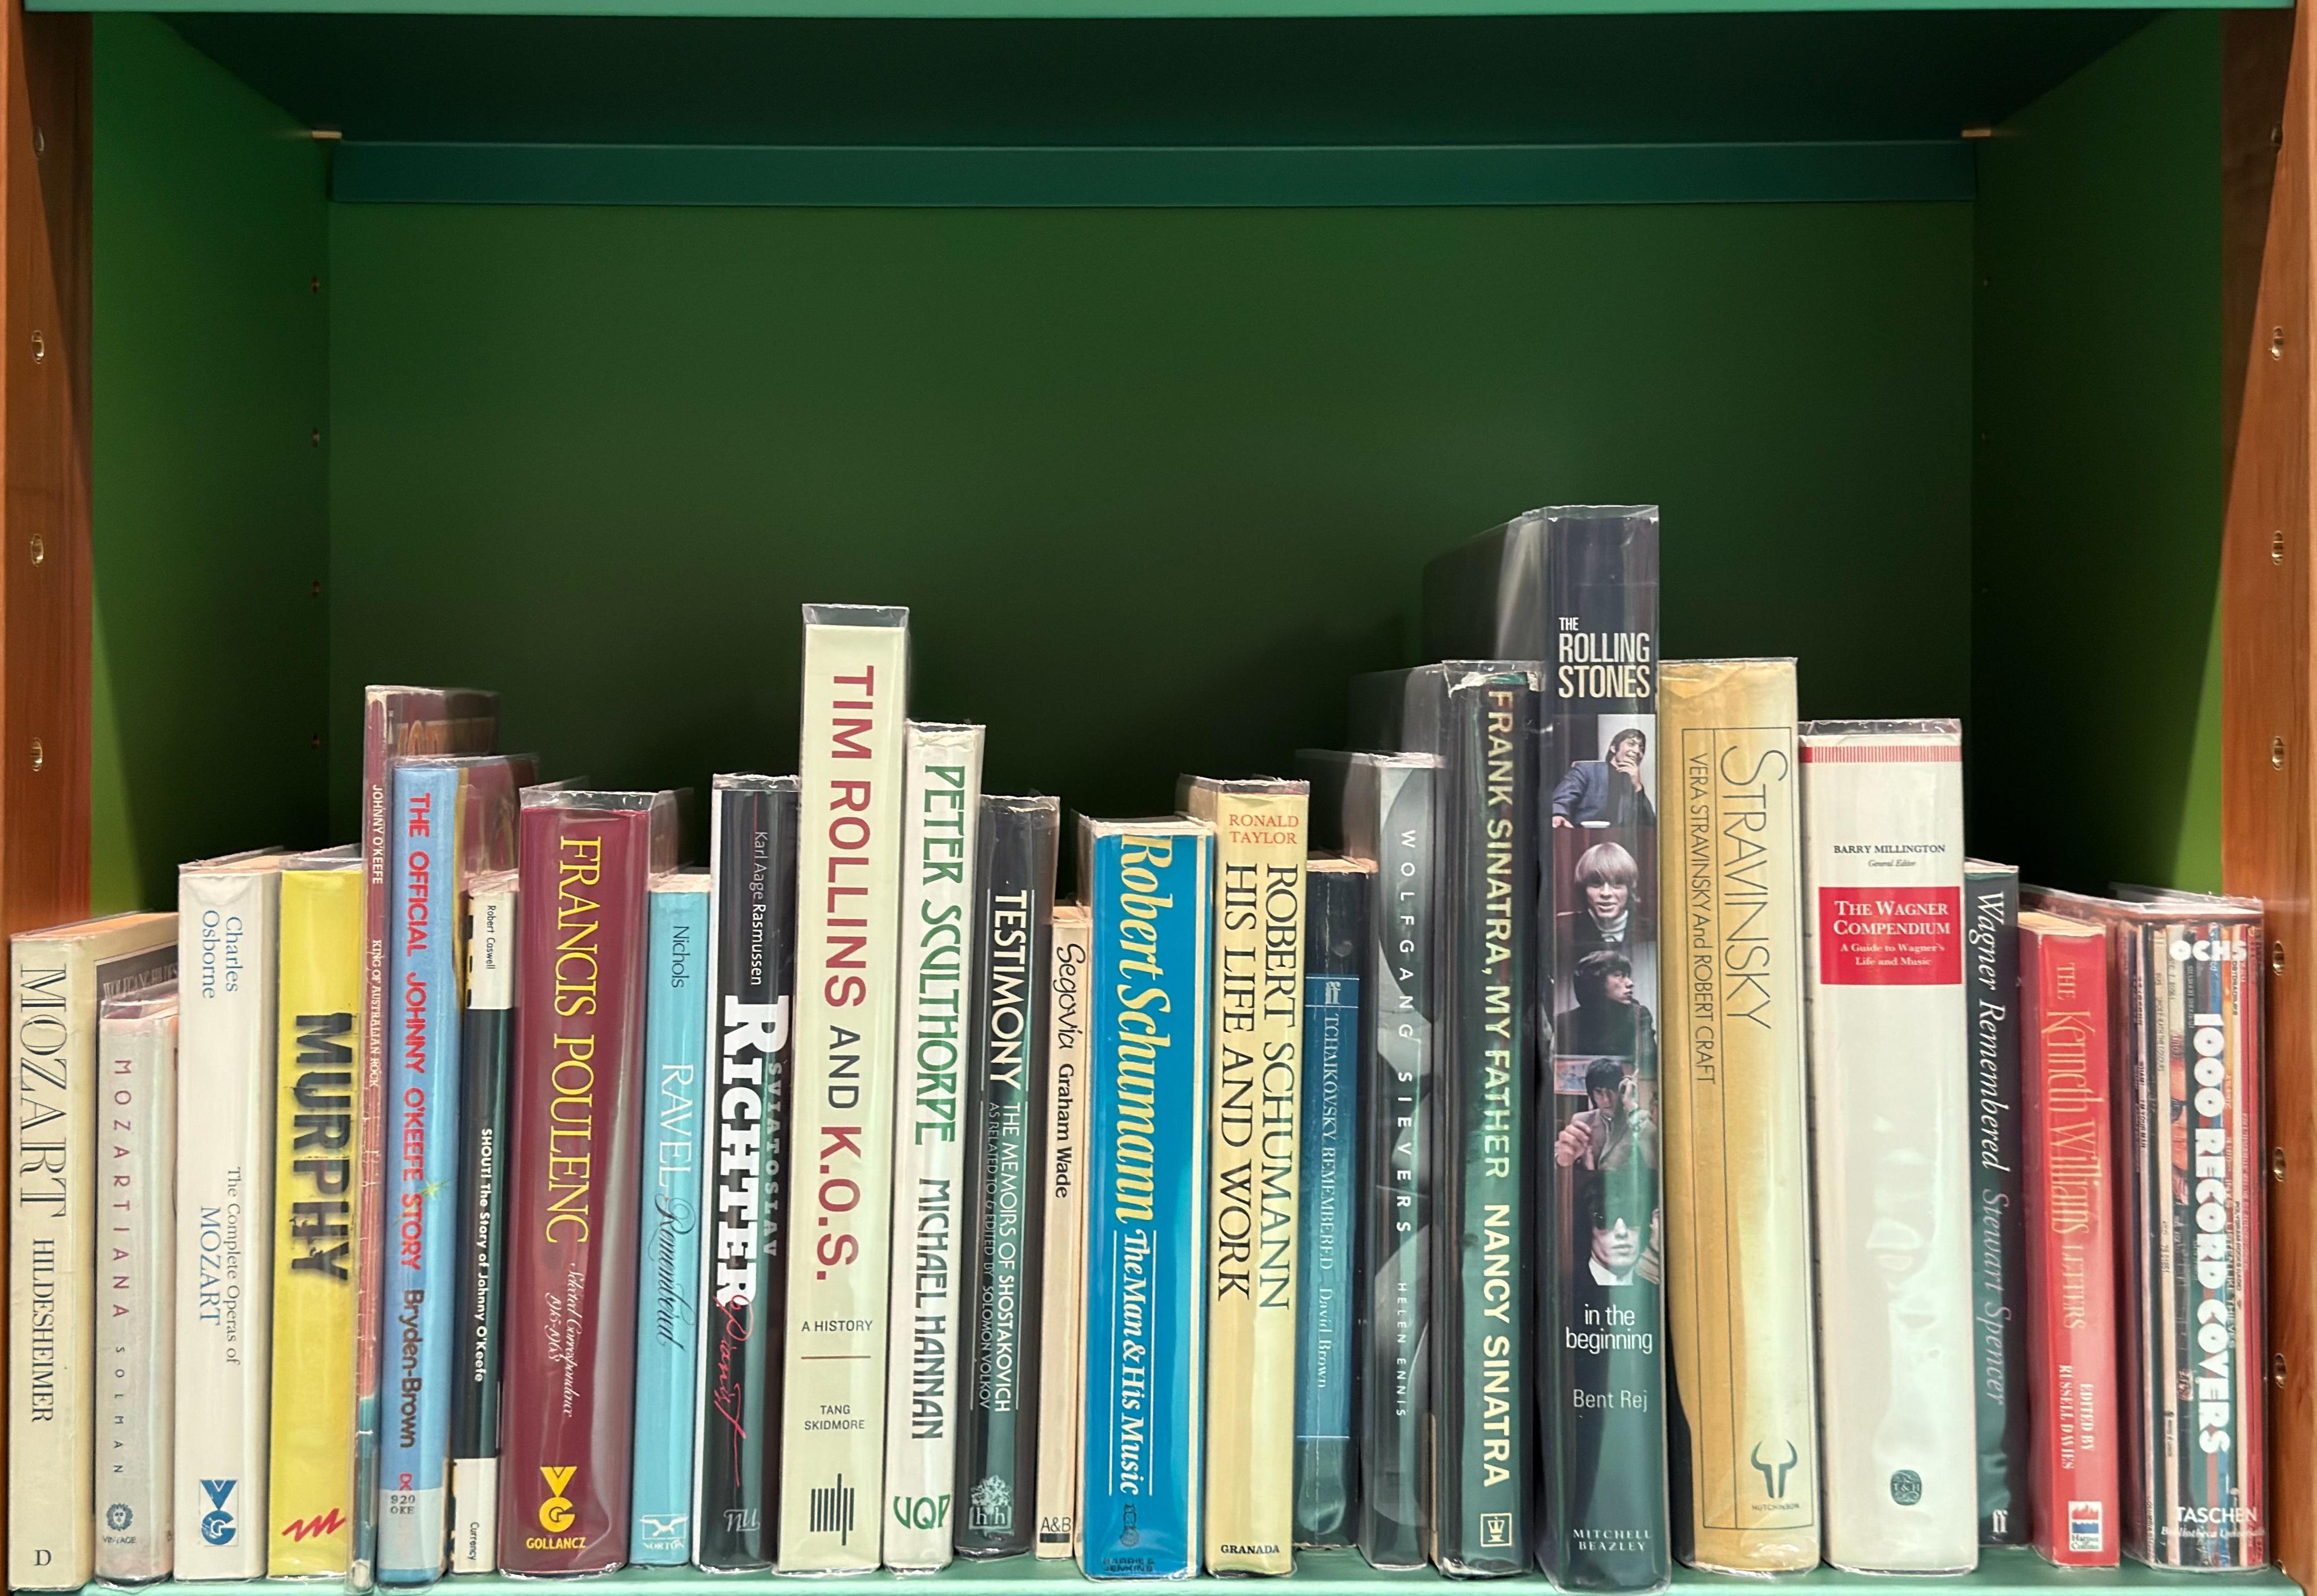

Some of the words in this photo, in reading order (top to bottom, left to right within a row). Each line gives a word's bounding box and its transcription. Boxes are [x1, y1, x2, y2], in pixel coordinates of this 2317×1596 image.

[1559, 617, 1579, 631] THE
[1559, 633, 1650, 663] ROLLING
[1558, 665, 1650, 698] STONES
[832, 665, 874, 759] TIM
[1488, 691, 1513, 805] FRANK
[1689, 753, 1708, 801] VERA
[373, 785, 383, 836] JOHNNY
[409, 792, 431, 838] THE
[923, 766, 965, 886] PETER
[1229, 814, 1299, 827] RONALD
[1230, 830, 1298, 845] TAYLOR
[372, 837, 383, 884] O'KEEFE
[754, 831, 768, 858] Karl
[1690, 805, 1711, 912] STRAVINSKY
[1834, 845, 1871, 853] BARRY
[1874, 845, 1945, 853] MILLINGTON
[406, 851, 430, 957] OFFICIAL
[749, 863, 767, 900] Aage
[824, 780, 871, 1007] ROLLINS
[1117, 835, 1173, 980] Robert
[1225, 862, 1258, 931] HIS
[1482, 819, 1513, 976] SINATRA,
[1720, 745, 1788, 1029] STRAVINSKY
[487, 906, 496, 933] Robert
[554, 836, 601, 1016] FRANCIS
[750, 904, 766, 985] Rasmussen
[1263, 863, 1298, 1027] ROBERT
[1399, 830, 1416, 1037] WOLFGANG
[1692, 913, 1711, 949] And
[1833, 920, 1950, 935] COMPENDIUM
[1840, 943, 1849, 952] A
[1851, 943, 1882, 952] Guide
[1898, 943, 1945, 954] Wagner's
[1969, 891, 2006, 991] Wagner
[202, 910, 216, 999] Osborne
[226, 916, 244, 992] Charles
[373, 940, 382, 968] KING
[373, 970, 382, 983] OF
[486, 937, 496, 969] Caswell
[672, 926, 690, 988] Nichols
[1855, 956, 1876, 965] Life
[1878, 956, 1898, 965] and
[1901, 956, 1931, 965] Music
[2169, 940, 2246, 961] OCHS
[990, 890, 1027, 1090] TESTIMONY
[1054, 943, 1085, 1049] Segovia
[1223, 946, 1256, 1033] LIFE
[1693, 955, 1714, 1021] ROBERT
[2056, 962, 2075, 1000] THE
[370, 985, 381, 1055] AUSTRALIAN
[404, 973, 427, 1073] JOHNNY
[915, 899, 962, 1145] SCULTHORPE
[1485, 986, 1510, 1038] MY
[370, 1060, 379, 1087] ROCK
[828, 1025, 861, 1109] AND
[1322, 1013, 1339, 1141] TCHAIKOVSKY
[1695, 1025, 1716, 1085] CRAFT
[2041, 1011, 2104, 1112] Kenneth
[2194, 1014, 2225, 1117] 1000
[20, 964, 67, 1217] MOZART
[988, 1102, 999, 1122] AS
[1056, 1064, 1074, 1141] Graham
[1115, 985, 1171, 1224] Schumann
[1221, 1044, 1254, 1147] AND
[1484, 1050, 1510, 1178] FATHER
[1979, 999, 2011, 1172] Remembered
[290, 1012, 353, 1281] MURPHY
[403, 1087, 425, 1182] O'KEEFE
[546, 1033, 595, 1243] POULENC
[659, 1064, 693, 1188] RAVEL
[987, 1123, 999, 1173] RELATED
[1002, 1102, 1020, 1136] THE
[481, 1129, 493, 1177] SHOUT!
[716, 995, 789, 1307] RICHTER
[763, 1062, 782, 1256] SVIATOSLAV
[1056, 1147, 1073, 1199] Wade
[1259, 1042, 1295, 1310] SCHUMANN
[1396, 1072, 1412, 1232] SIEVERS
[2050, 1118, 2102, 1234] Williams
[112, 1059, 132, 1317] MOZARTIANA
[228, 1166, 241, 1197] The
[480, 1183, 492, 1207] The
[817, 1127, 862, 1280] K.O.S.
[986, 1176, 998, 1195] TO
[999, 1142, 1019, 1236] MEMOIRS
[1319, 1147, 1336, 1270] REMEMBERED
[2195, 1129, 2228, 1288] RECORD
[225, 1203, 241, 1280] Complete
[401, 1194, 424, 1271] STORY
[477, 1212, 490, 1248] Story
[915, 1178, 950, 1308] MICHAEL
[984, 1214, 997, 1256] EDITED
[998, 1242, 1015, 1270] OF
[1124, 1229, 1150, 1276] The
[1218, 1158, 1252, 1302] WORK
[1982, 1189, 2010, 1295] Stewart
[199, 1207, 221, 1326] MOZART
[479, 1254, 489, 1268] of
[1483, 1204, 1510, 1323] NANCY
[2062, 1245, 2086, 1330] LETTERS
[226, 1286, 240, 1342] Operas
[475, 1272, 489, 1321] Johnny
[802, 1321, 810, 1332] A
[815, 1320, 873, 1332] HISTORY
[980, 1285, 994, 1351] SOLOMON
[1122, 1276, 1146, 1336] Man
[1318, 1288, 1333, 1337] David
[1396, 1283, 1408, 1343] HELEN
[1585, 1303, 1600, 1325] in
[1606, 1304, 1635, 1326] the
[31, 1238, 55, 1422] HILDESHEIMER
[227, 1347, 240, 1365] of
[474, 1326, 487, 1382] O'Keefe
[995, 1275, 1014, 1412] SHOSTAKOVICH
[1566, 1327, 1652, 1354] beginning
[1976, 1301, 2012, 1405] Spencer
[399, 1290, 425, 1448] Bryden-Brown
[912, 1315, 947, 1439] HANNAN
[979, 1357, 992, 1410] VOLKOV
[1121, 1363, 1145, 1410] His
[1317, 1342, 1332, 1389] Brown
[1396, 1358, 1407, 1417] ENNIS
[2059, 1364, 2074, 1420] RUSSELL
[2197, 1299, 2230, 1453] COVERS
[113, 1346, 125, 1473] SOLMAN
[804, 1420, 865, 1430] SKIDMORE
[820, 1405, 850, 1415] TANG
[1483, 1335, 1510, 1487] SINATRA
[1573, 1389, 1613, 1409] Bent
[1620, 1391, 1648, 1412] Rej
[2080, 1383, 2094, 1431] EDITED
[1120, 1413, 1144, 1496] Music
[2080, 1436, 2095, 1450] BY
[391, 1495, 415, 1504] 920
[391, 1505, 414, 1515] OKE
[894, 1494, 950, 1530] UQP
[1041, 1517, 1071, 1532] A&B
[2176, 1507, 2257, 1523] TASCHEN
[34, 1550, 51, 1566] D
[467, 1522, 479, 1560] Currency
[526, 1537, 587, 1550] GOLLANCZ
[643, 1540, 685, 1550] NORTON
[1221, 1545, 1280, 1555] GRANADA
[1573, 1529, 1652, 1539] MITCHELL
[1579, 1541, 1646, 1552] BEAZLEY
